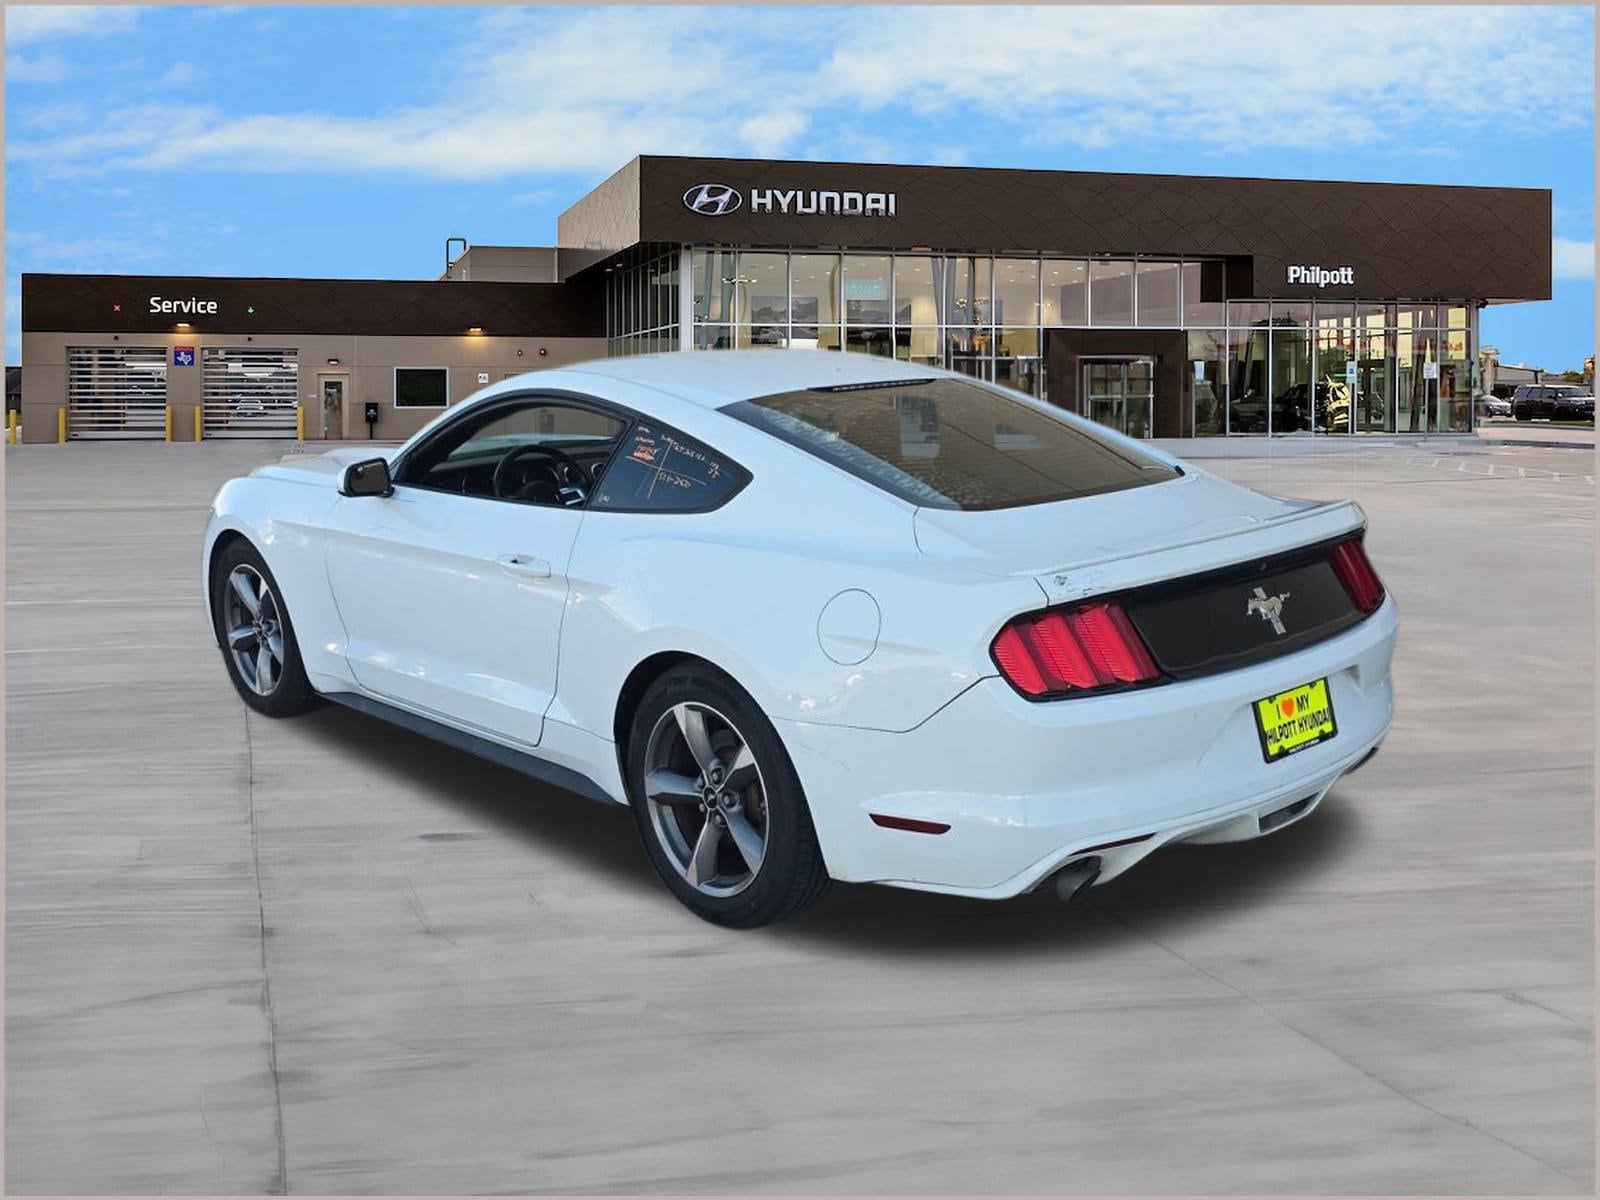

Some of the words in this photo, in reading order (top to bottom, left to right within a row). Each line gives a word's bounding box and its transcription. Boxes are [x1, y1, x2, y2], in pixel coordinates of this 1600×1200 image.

[751, 189, 896, 216] HYUNDAI
[1287, 265, 1354, 288] Philpott
[149, 296, 218, 314] Service
[1296, 693, 1309, 713] MY
[1266, 720, 1298, 745] HILPOTT
